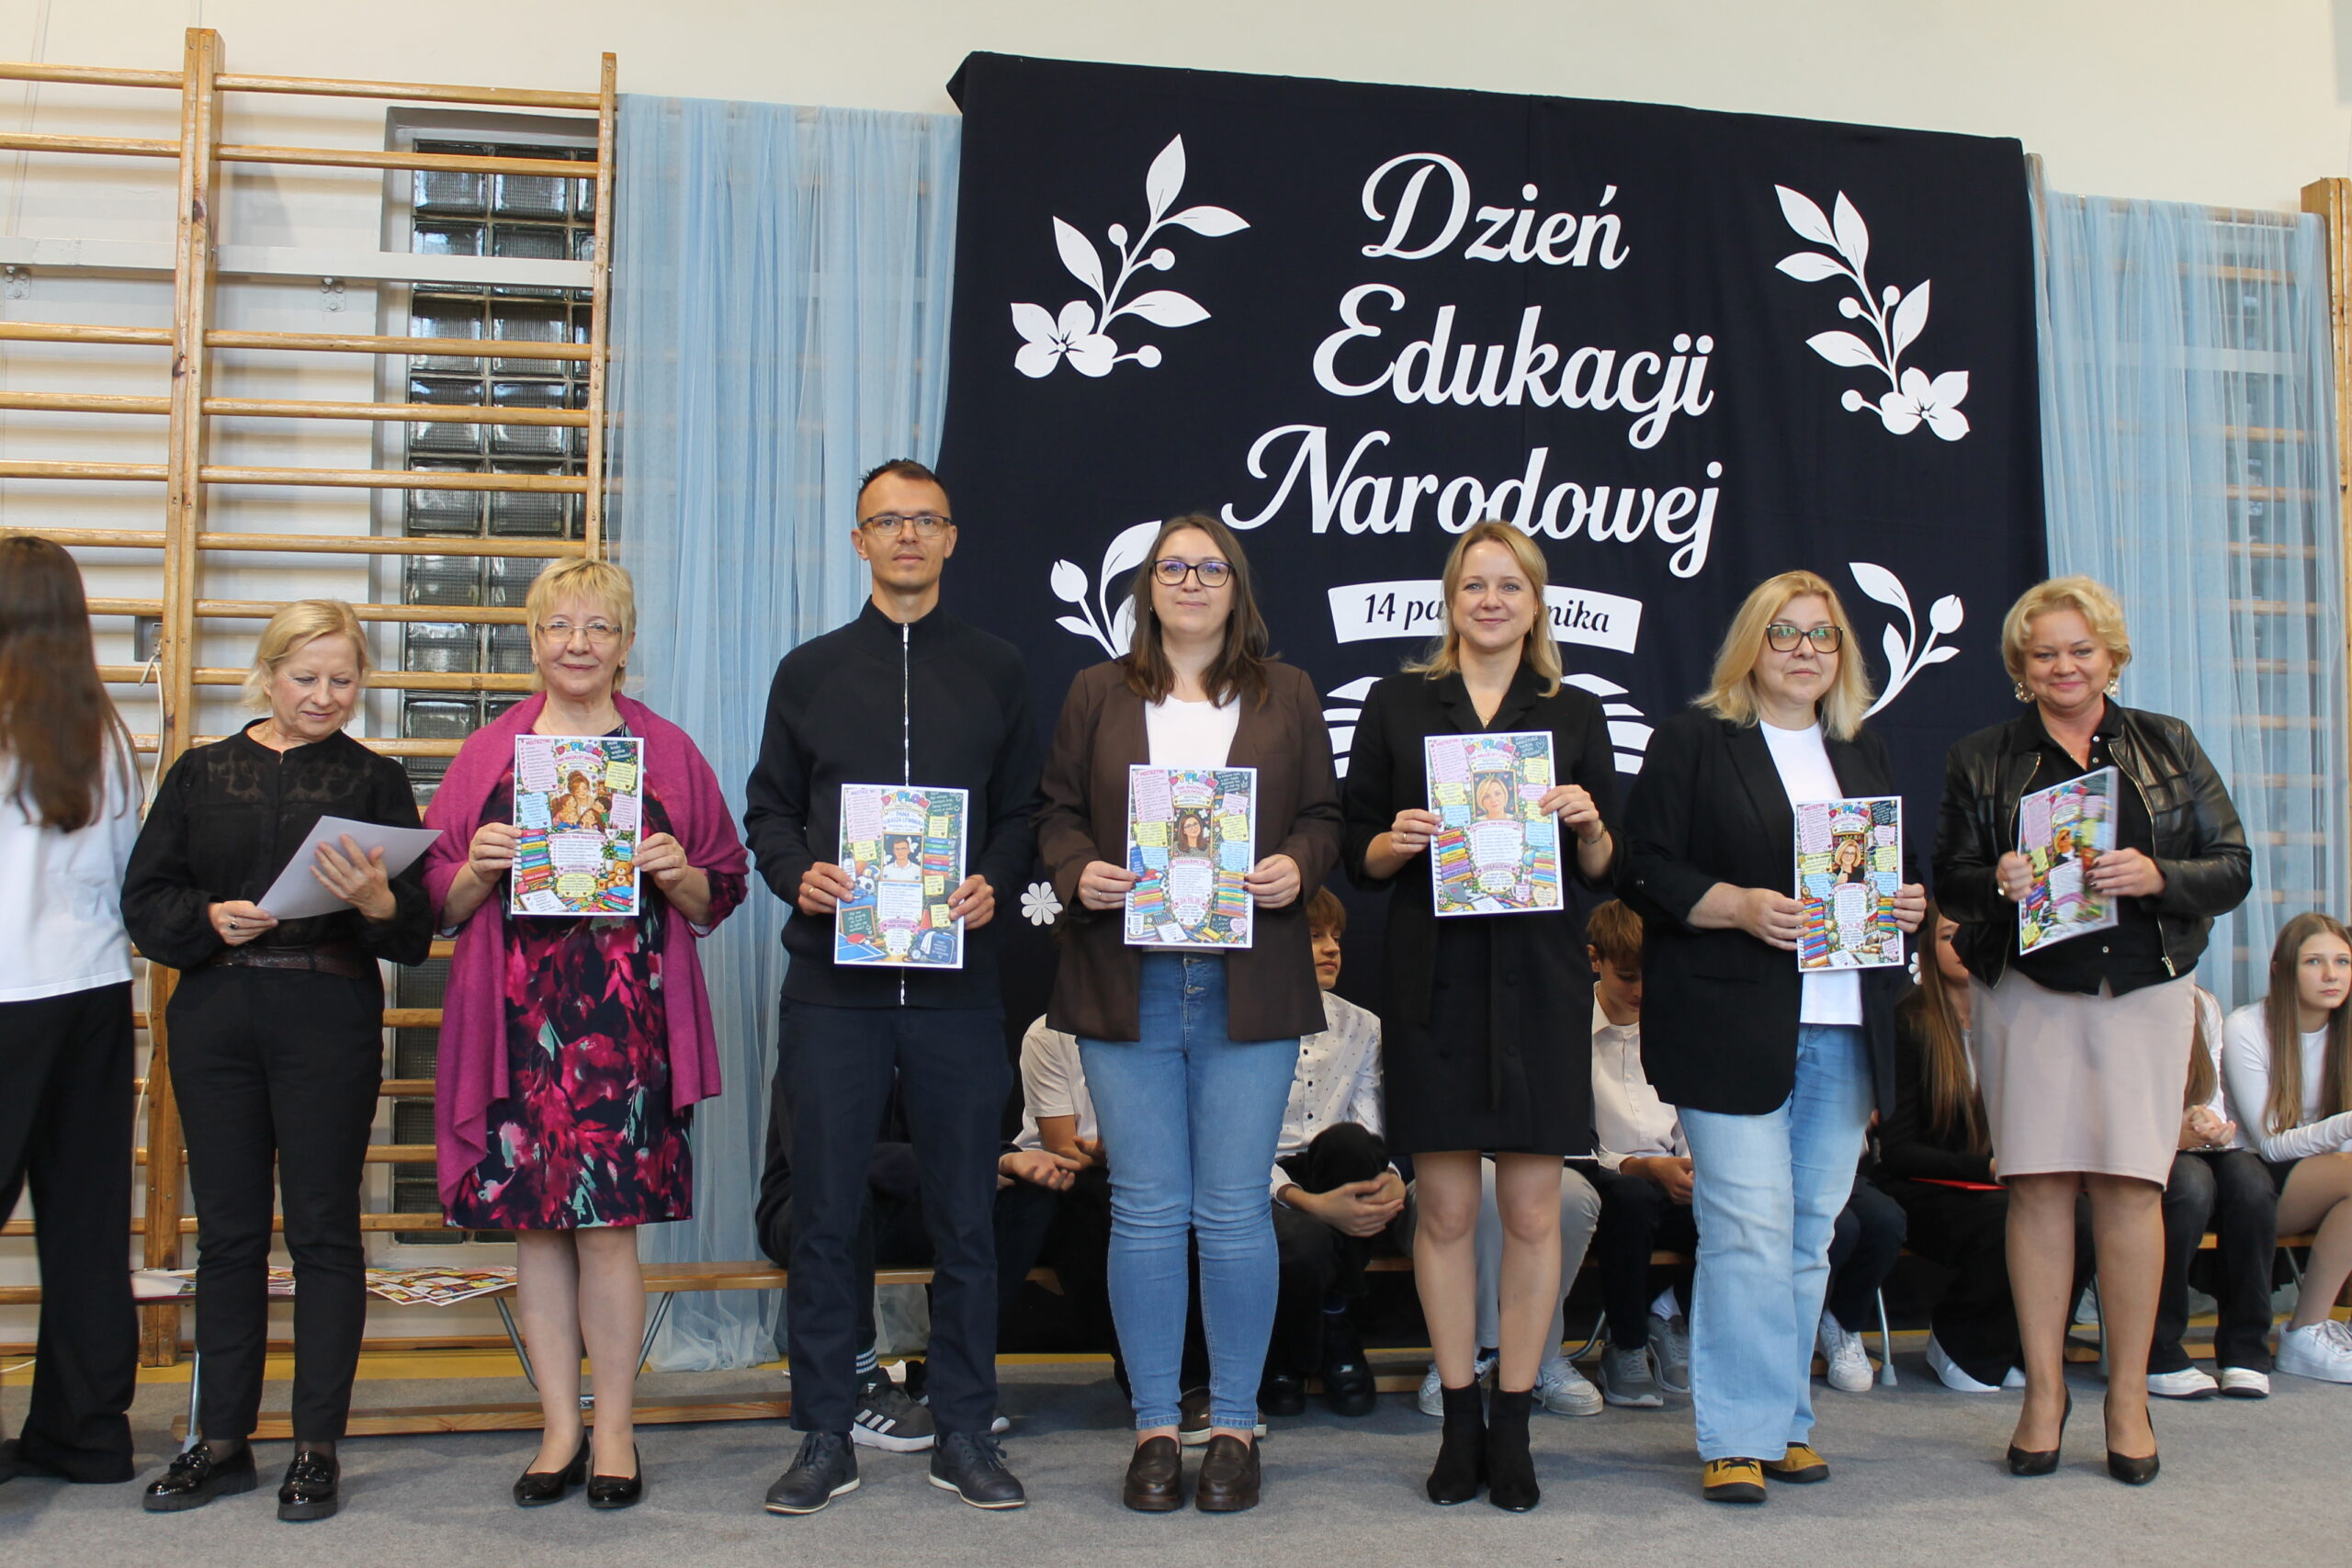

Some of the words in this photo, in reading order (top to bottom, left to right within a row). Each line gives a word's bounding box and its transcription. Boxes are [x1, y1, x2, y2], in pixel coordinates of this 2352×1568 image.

[1362, 152, 1630, 270] Dzień
[1312, 283, 1714, 450] Edukacji
[1220, 423, 1723, 579] Narodowej
[1364, 592, 1396, 623] 14
[555, 741, 605, 758] DYPLOM
[1169, 773, 1219, 789] DYPLOM
[880, 791, 932, 808] DYPLOM
[1828, 805, 1871, 818] DYPLOM
